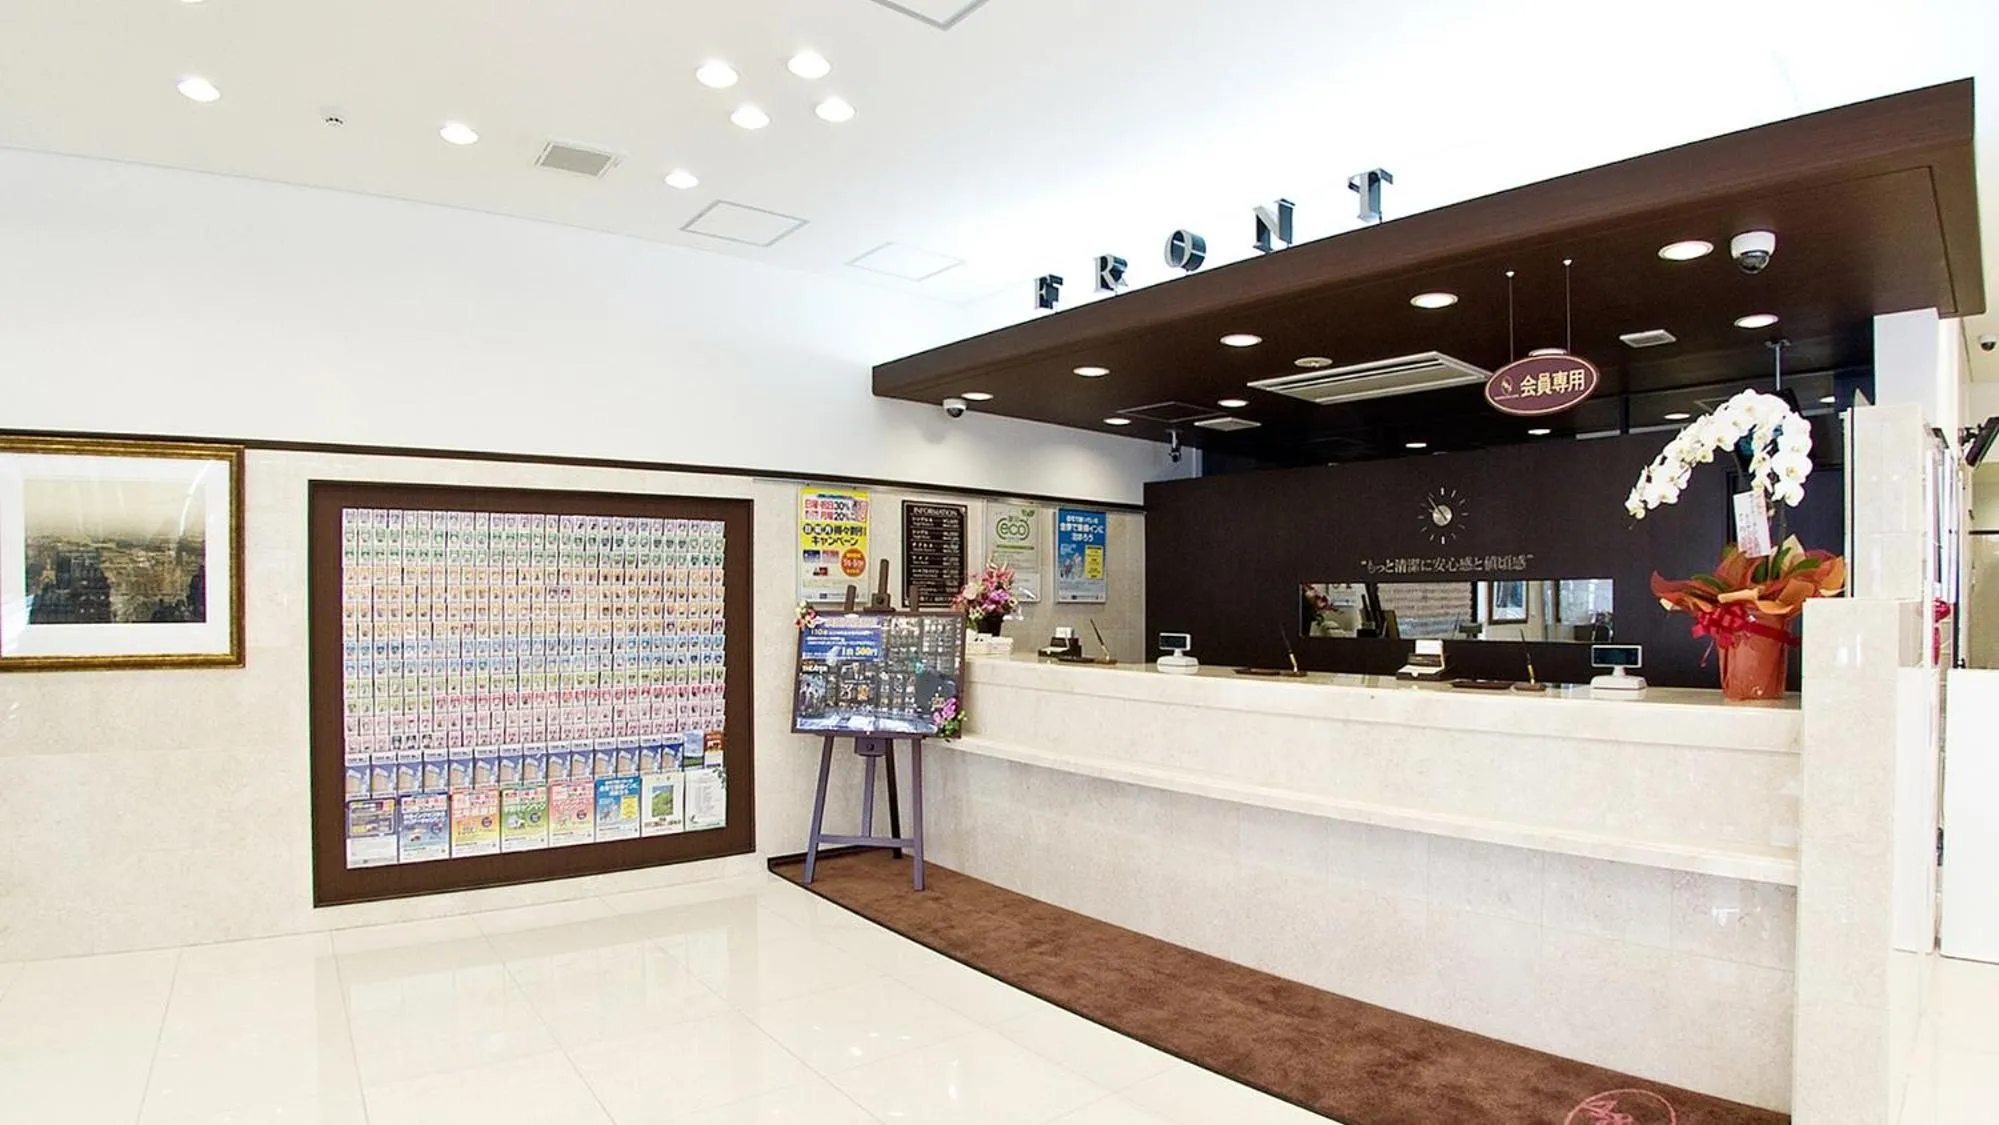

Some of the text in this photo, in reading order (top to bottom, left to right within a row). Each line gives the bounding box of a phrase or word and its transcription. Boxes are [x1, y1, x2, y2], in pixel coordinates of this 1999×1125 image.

[1034, 167, 1394, 310] FRONT
[1519, 369, 1586, 398] 会員専用
[1000, 522, 1027, 536] eco
[811, 535, 859, 547] キャンペーン
